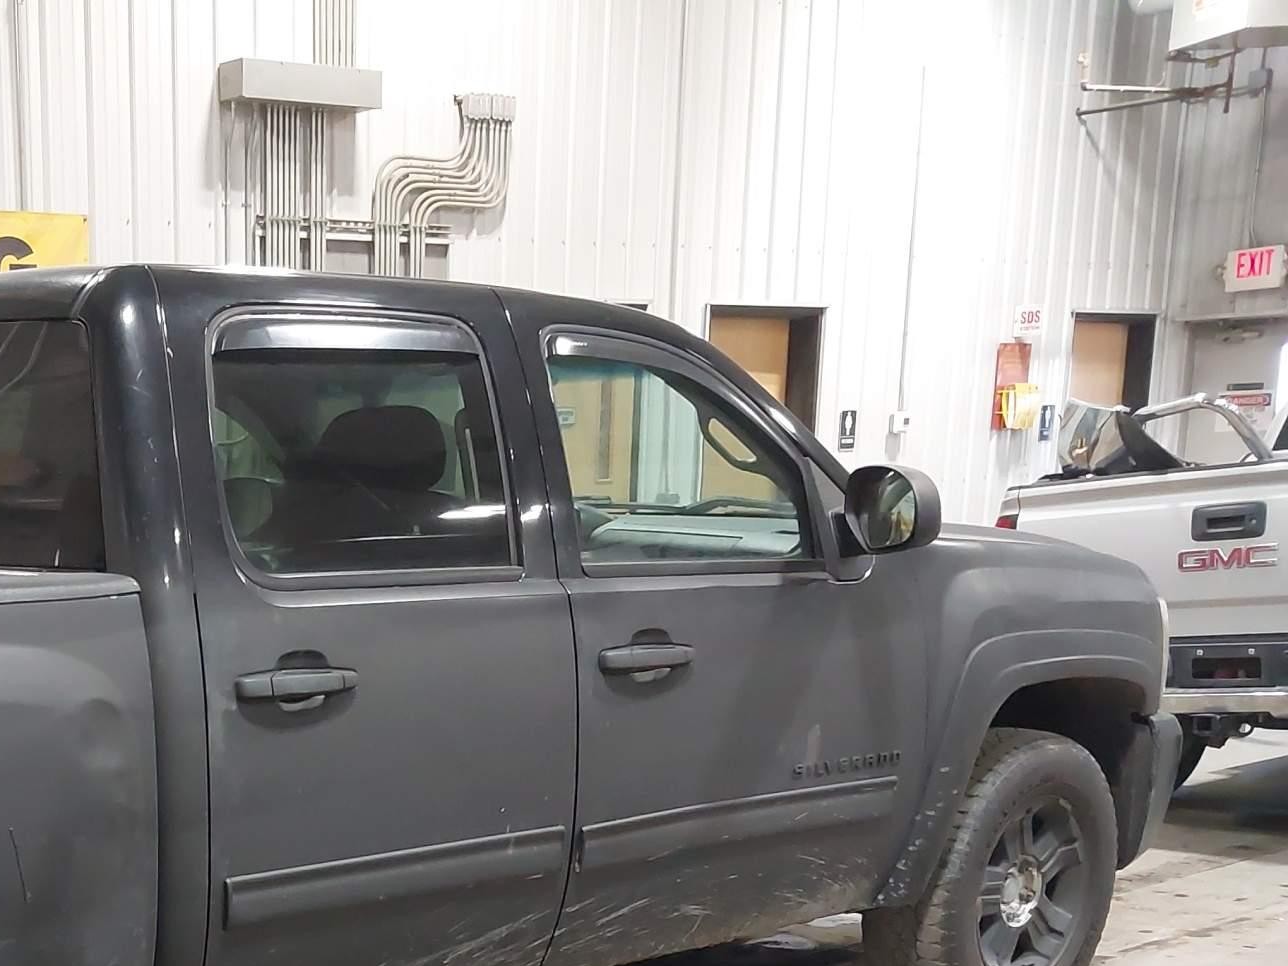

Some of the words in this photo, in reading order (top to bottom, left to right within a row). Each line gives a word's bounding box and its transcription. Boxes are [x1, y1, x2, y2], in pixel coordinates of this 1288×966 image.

[1236, 249, 1274, 278] EXIT
[1020, 310, 1041, 324] SDS
[1177, 542, 1279, 573] GMC
[792, 750, 901, 777] SILVERADO
